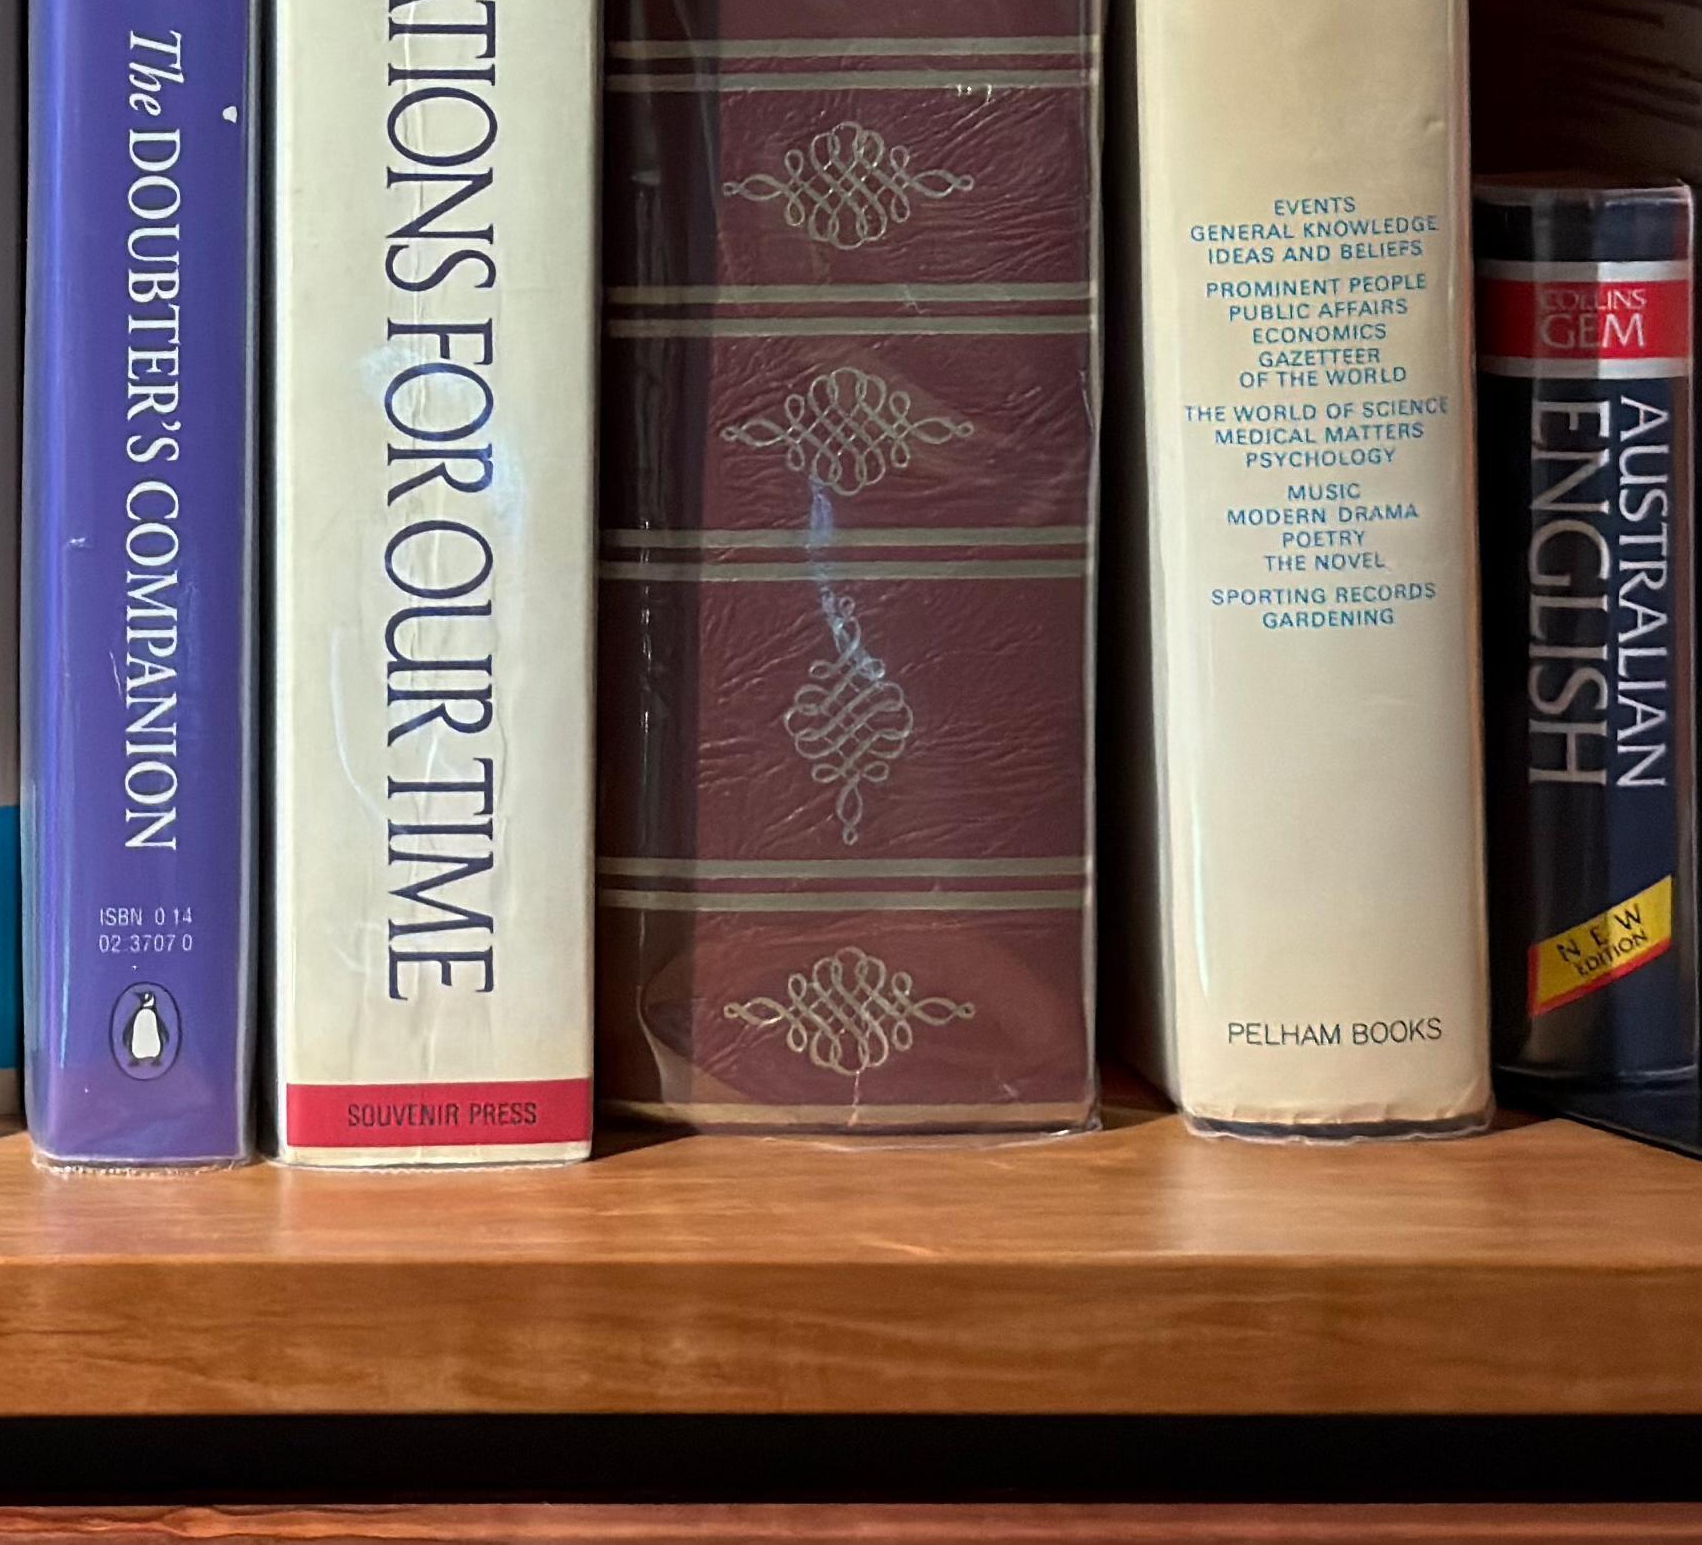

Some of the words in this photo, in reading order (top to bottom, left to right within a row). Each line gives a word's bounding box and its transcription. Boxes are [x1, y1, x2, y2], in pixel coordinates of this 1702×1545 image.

[129, 30, 182, 117] The
[1274, 197, 1356, 216] EVENTS
[1190, 222, 1294, 242] GENERAL
[1302, 215, 1438, 238] KNOWLEDGE
[1208, 247, 1274, 265] IDEAS
[1282, 245, 1331, 263] AND
[1340, 240, 1423, 259] BELIEFS
[125, 131, 181, 464] DOUBTER'S
[1206, 278, 1341, 299] PROMINENT
[1349, 273, 1427, 293] PEOPLE
[1228, 303, 1310, 322] PUBLIC
[1317, 299, 1408, 318] AFFAIRS
[1541, 288, 1647, 312] COLLINS
[1252, 323, 1386, 344] ECONOMICS
[1541, 313, 1646, 349] GEM
[1258, 348, 1381, 368] GAZETTEER
[1239, 371, 1267, 388] OF
[1277, 370, 1319, 386] THE
[1325, 366, 1406, 384] WORLD
[384, 318, 493, 508] FOR
[1185, 404, 1226, 422] THE
[1233, 403, 1317, 422] WORLD
[1326, 401, 1356, 419] OF
[1362, 396, 1449, 416] SCIENCE
[1214, 427, 1316, 445] MEDICAL
[1324, 423, 1424, 441] MATTERS
[1246, 447, 1396, 469] PSYCHOLOGY
[1287, 483, 1360, 500] MUSIC
[1227, 508, 1326, 526] MODERN
[1338, 503, 1418, 522] DRAMA
[1282, 530, 1365, 548] POETRY
[1265, 554, 1305, 572] THE
[1314, 552, 1386, 571] NOVEL
[1211, 587, 1326, 606] SPORTING
[1336, 583, 1436, 602] RECORDS
[1529, 399, 1612, 786] ENGLISH
[1616, 395, 1669, 788] AUSTRALIAN
[1262, 608, 1394, 628] GARDENING
[384, 519, 493, 748] OUR
[124, 480, 180, 851] COMPANION
[386, 756, 495, 1001] TIME
[100, 908, 142, 926] ISBN
[155, 907, 165, 925] 0
[174, 907, 192, 924] 14
[99, 934, 120, 953] 02
[130, 934, 175, 952] 3707
[182, 934, 192, 951] 0
[1557, 904, 1643, 961] NEW
[1575, 930, 1648, 978] EDITION
[1228, 1022, 1341, 1045] PELHAM
[1352, 1017, 1442, 1045] BOOKS
[347, 1101, 460, 1127] SOUVENIR
[469, 1101, 538, 1126] PRESS
